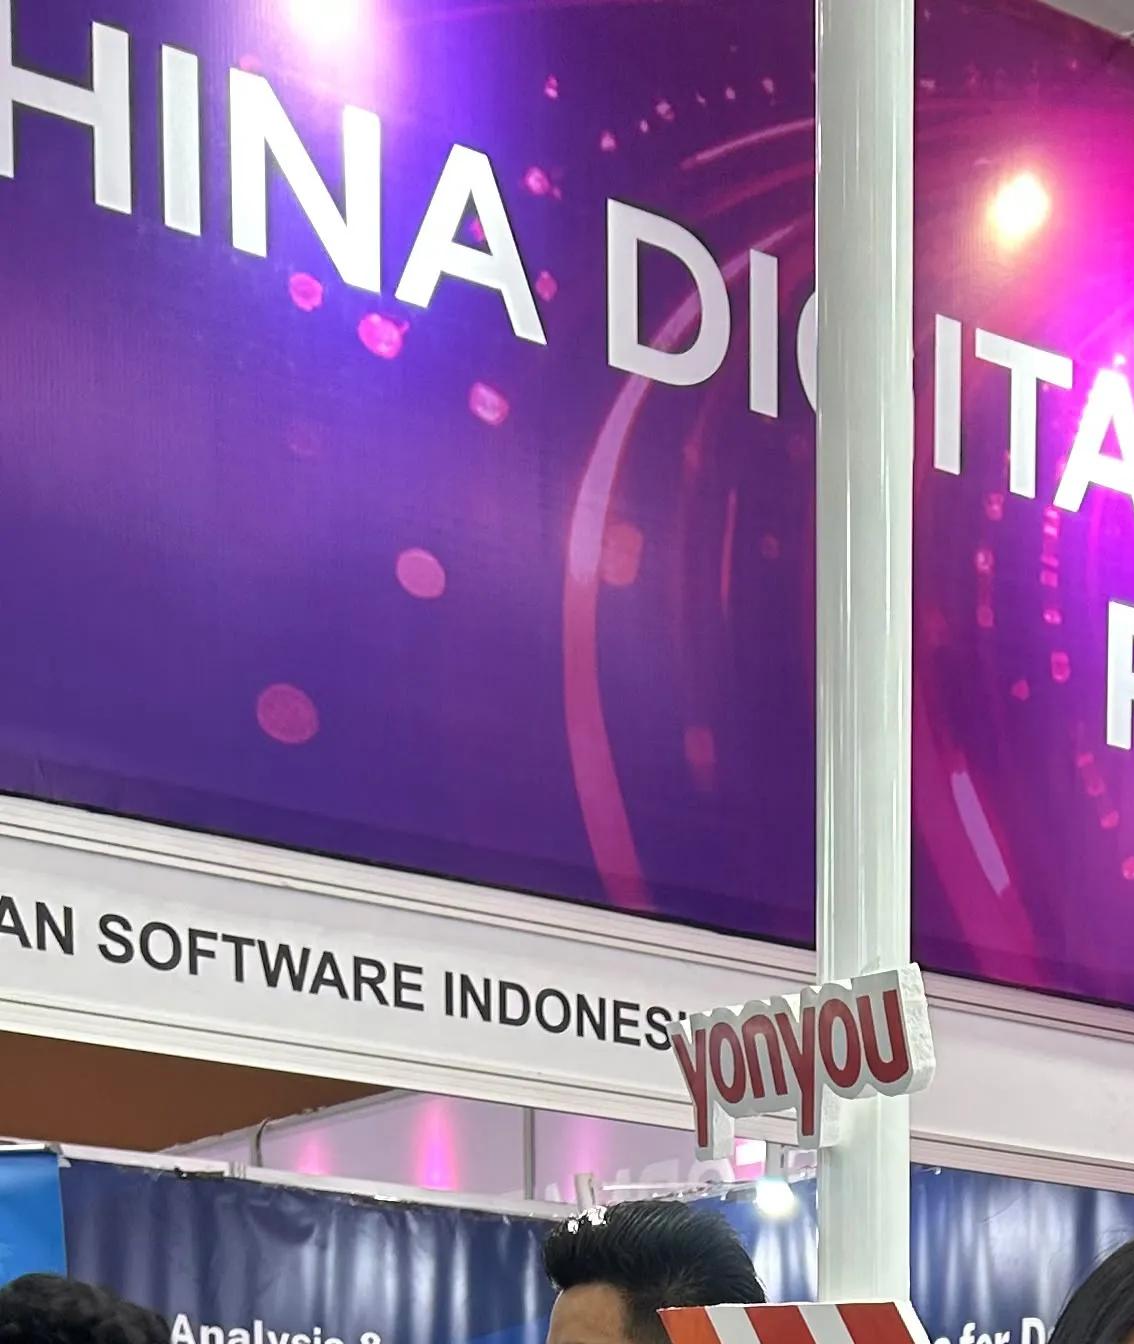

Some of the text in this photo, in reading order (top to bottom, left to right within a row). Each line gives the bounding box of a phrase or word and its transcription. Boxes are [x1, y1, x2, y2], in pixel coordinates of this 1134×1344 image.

[97, 913, 425, 1012] SOFTWARE
[444, 970, 687, 1051] INDONES
[671, 989, 910, 1148] yonyou
